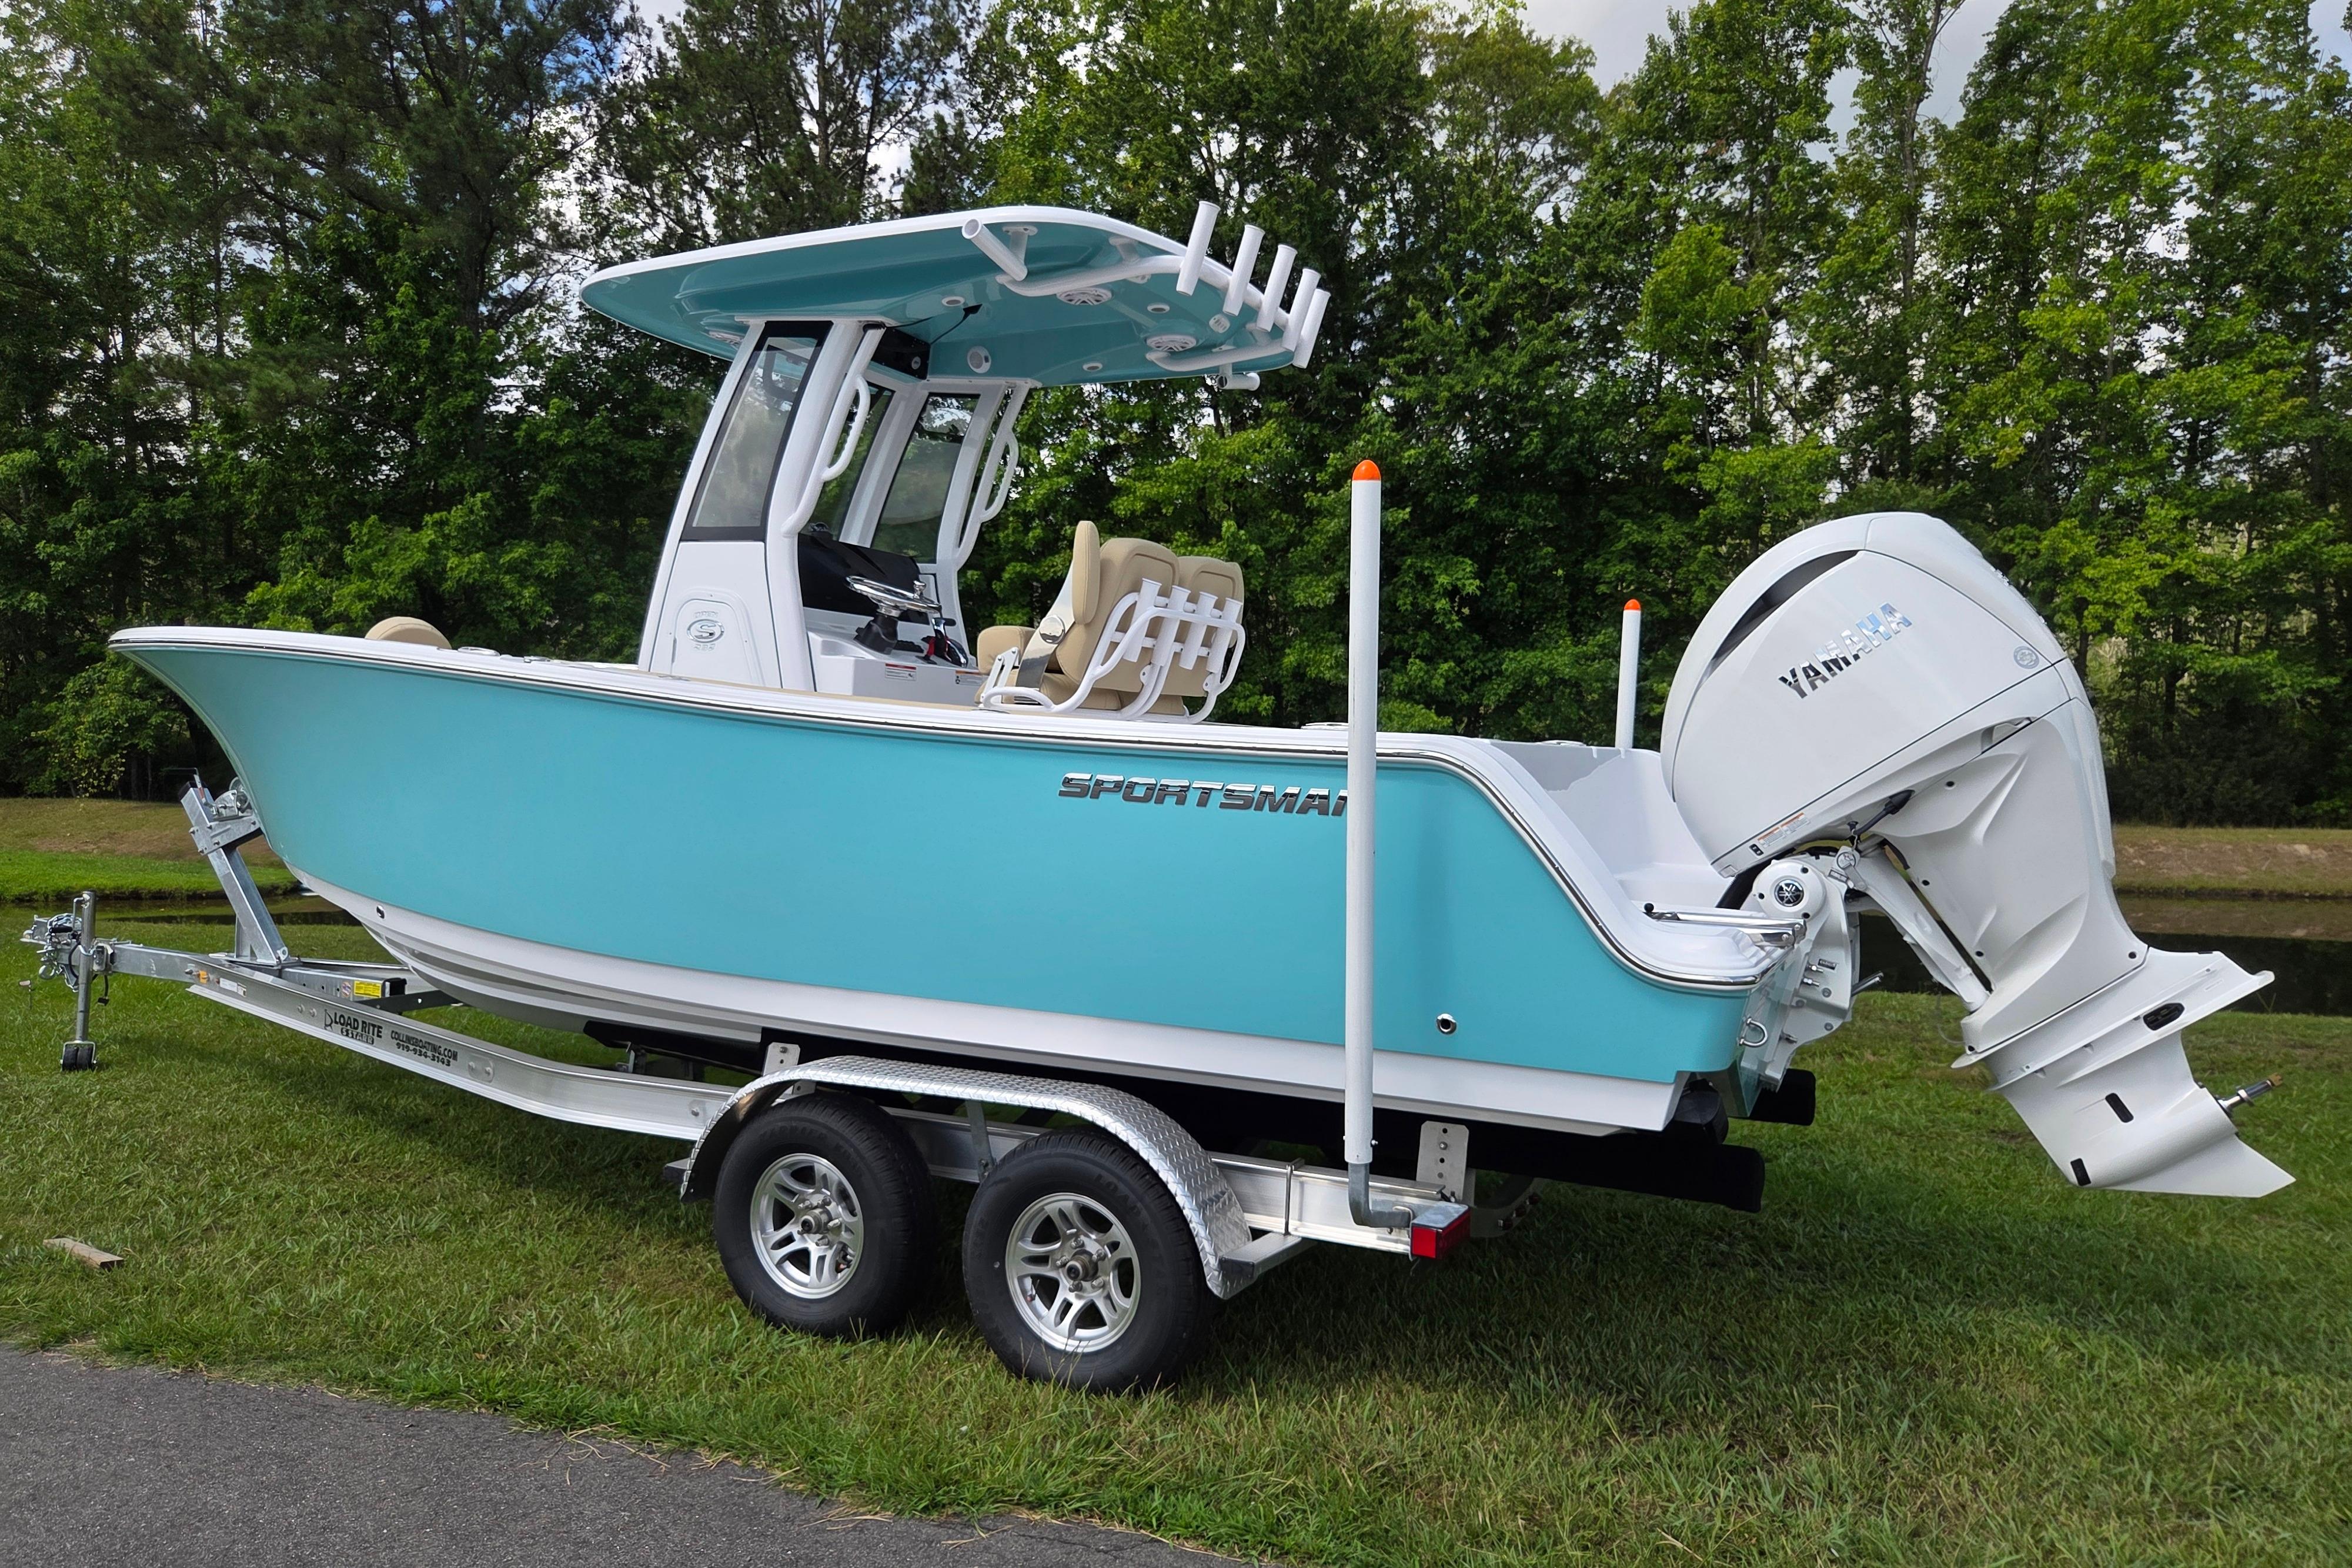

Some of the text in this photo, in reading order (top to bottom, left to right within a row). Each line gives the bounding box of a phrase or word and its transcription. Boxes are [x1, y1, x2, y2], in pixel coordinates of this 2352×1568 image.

[1778, 602, 1912, 699] YAMAHA
[334, 1012, 383, 1038] LOAD RITE
[390, 1030, 458, 1061] COLLINSBOATING.COM
[396, 1042, 451, 1066] 919-934-3143
